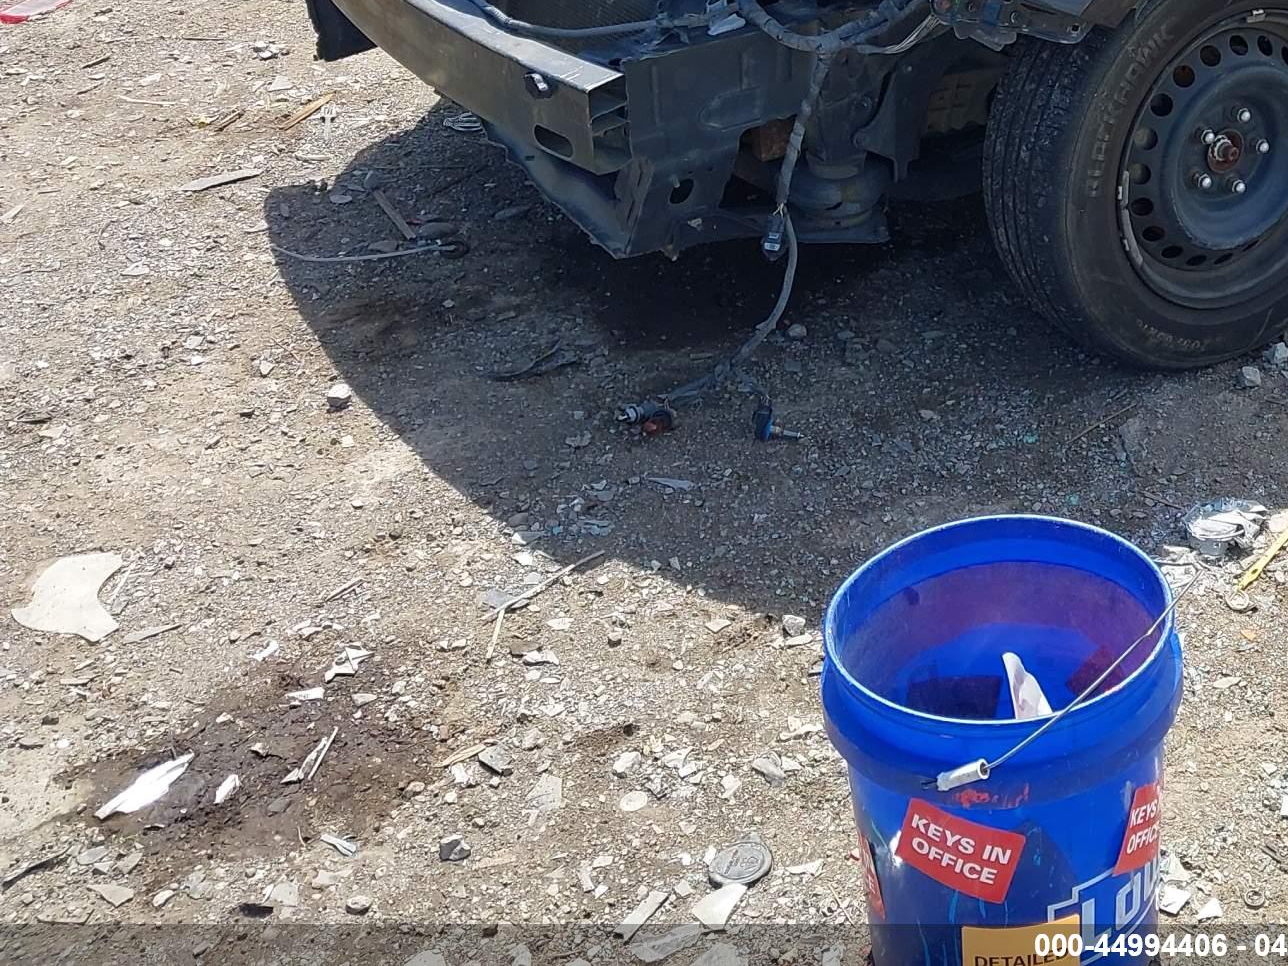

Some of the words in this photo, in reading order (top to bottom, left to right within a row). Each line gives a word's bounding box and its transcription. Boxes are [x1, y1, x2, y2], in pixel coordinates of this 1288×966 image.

[1129, 798, 1158, 828] KEYS
[911, 813, 976, 854] KEYS
[982, 845, 1012, 865] IN
[911, 837, 998, 885] OFFICE
